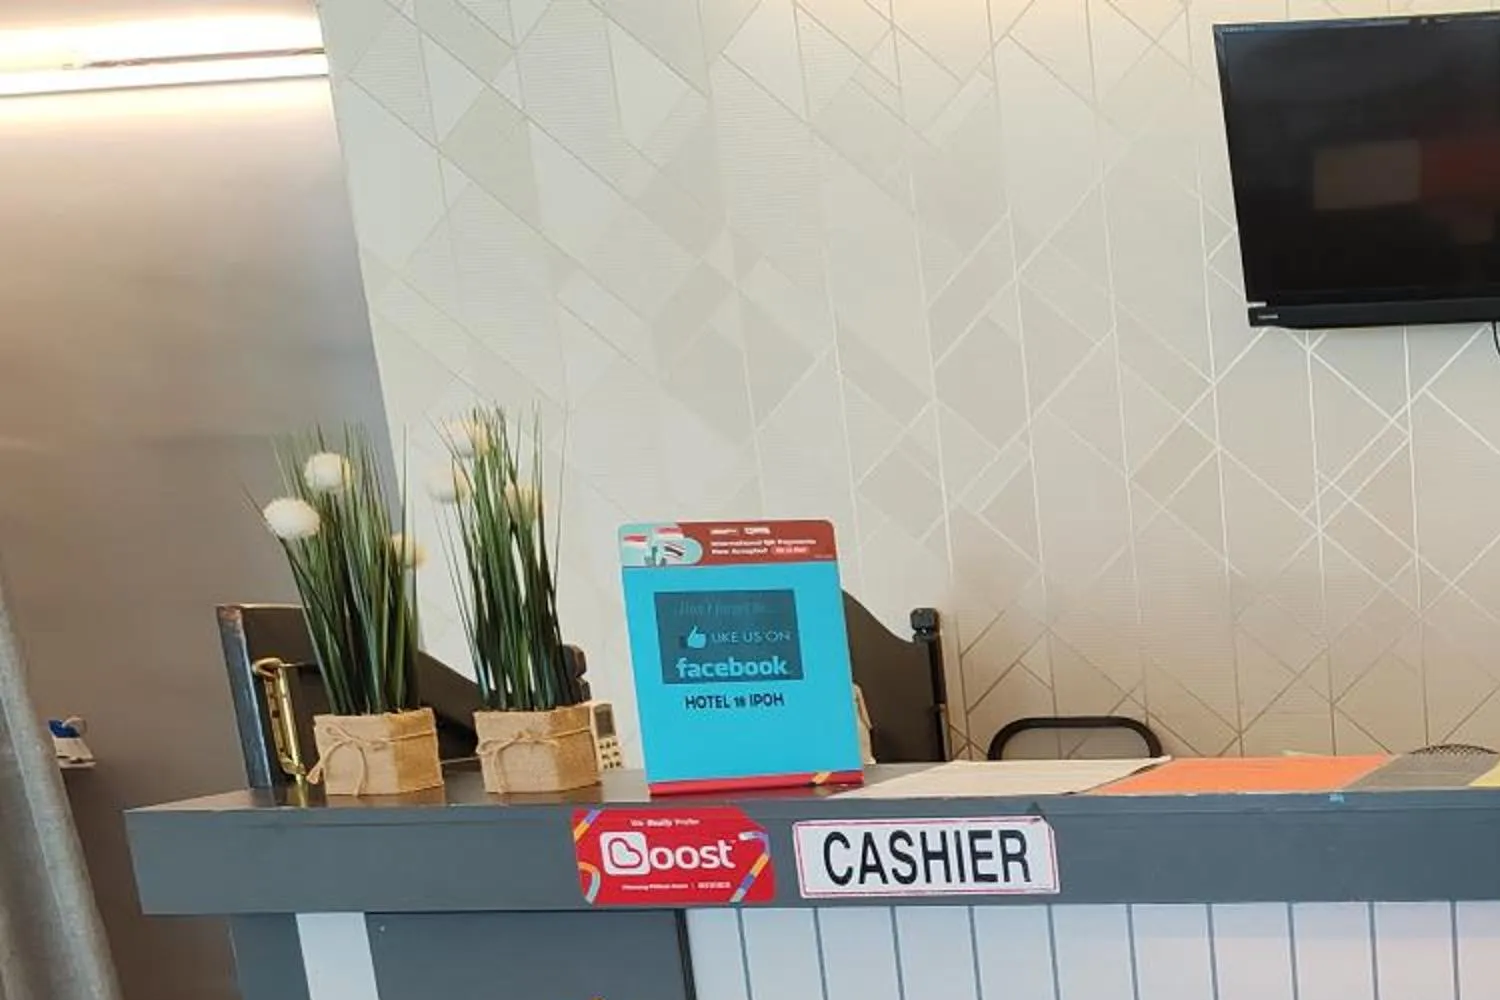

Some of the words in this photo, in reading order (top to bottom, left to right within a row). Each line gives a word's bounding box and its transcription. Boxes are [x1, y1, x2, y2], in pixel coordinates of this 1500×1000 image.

[710, 631, 740, 643] LIKE
[743, 631, 762, 643] US
[764, 630, 791, 641] ON
[675, 656, 789, 678] facebook
[685, 695, 731, 710] HOTEL
[749, 692, 785, 707] IPOH
[823, 829, 1032, 886] CASHIER
